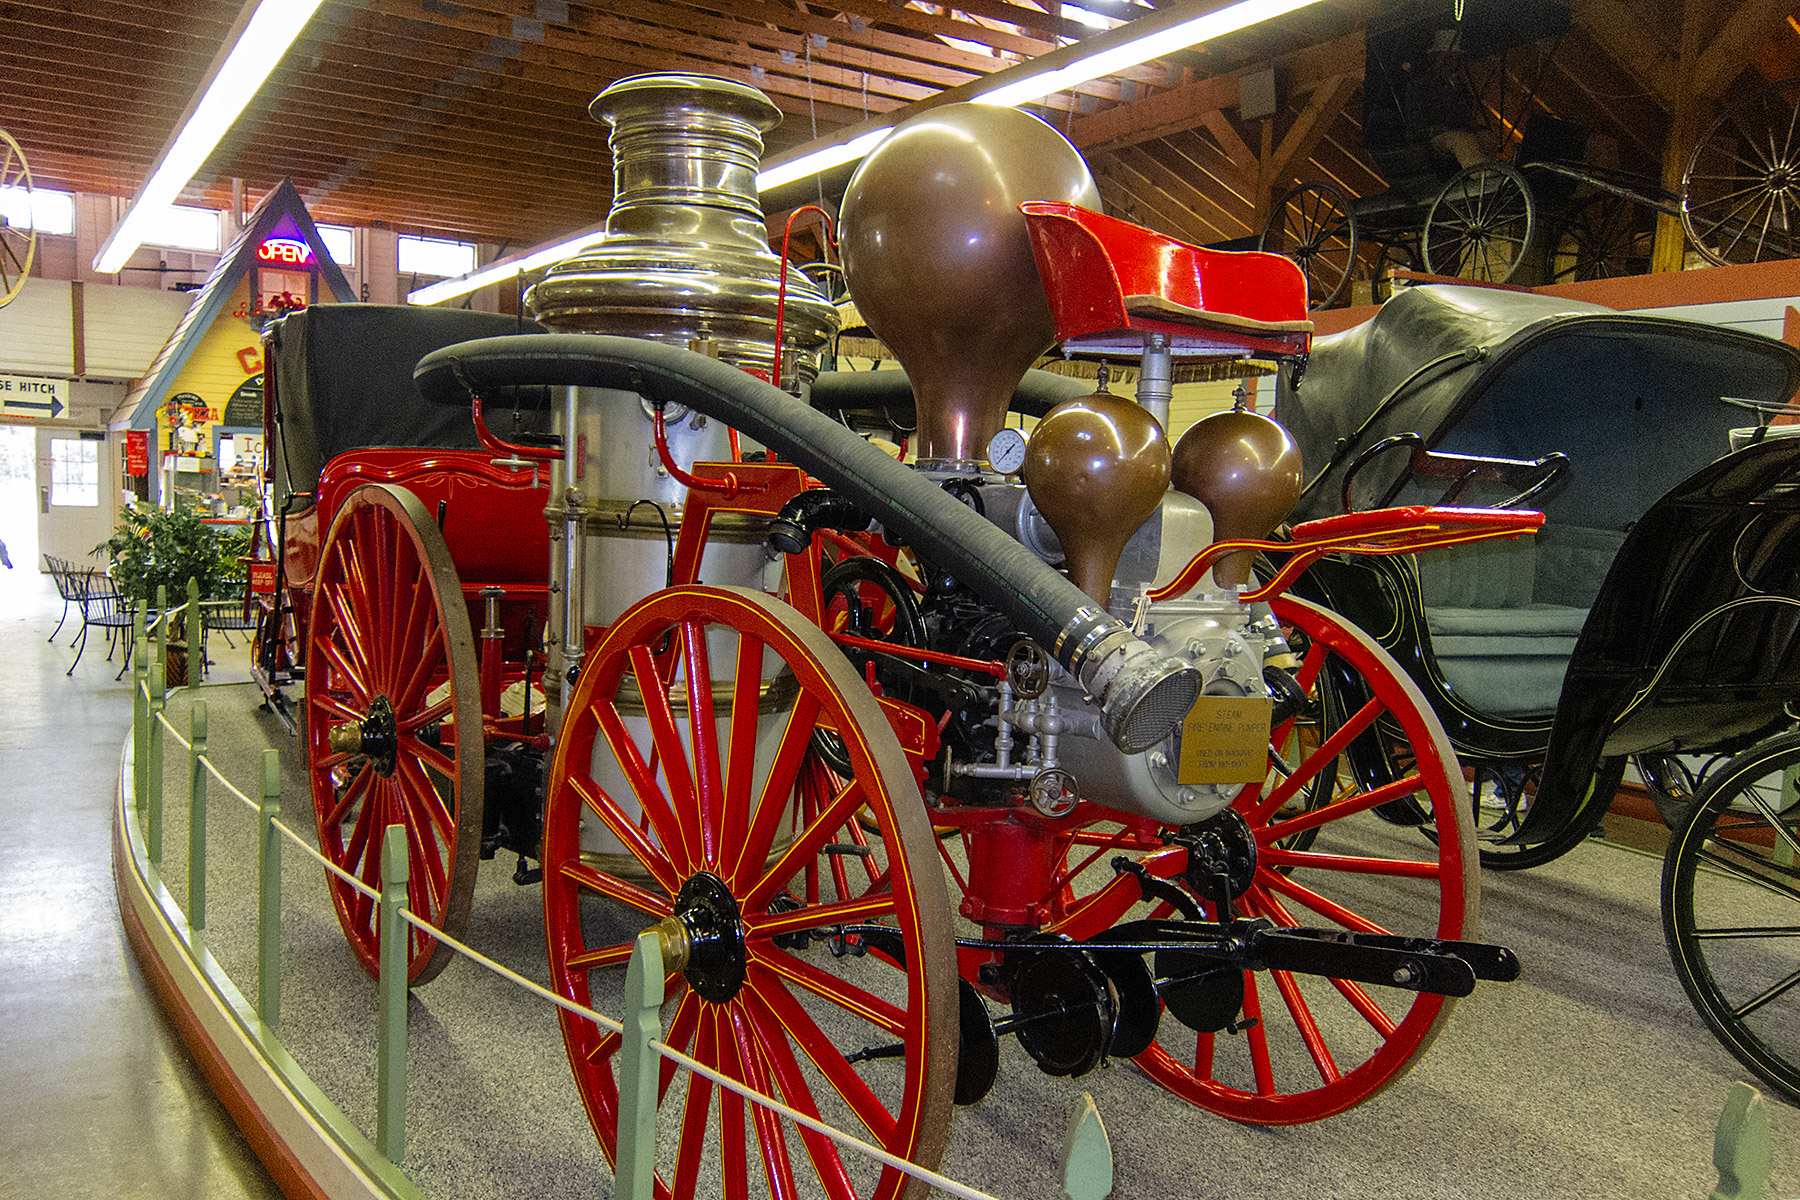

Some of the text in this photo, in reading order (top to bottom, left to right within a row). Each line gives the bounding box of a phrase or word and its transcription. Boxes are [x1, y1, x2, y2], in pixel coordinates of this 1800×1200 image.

[258, 242, 307, 263] OPEN
[19, 382, 55, 394] HITCH
[253, 571, 273, 579] PLEASE
[1216, 709, 1242, 719] STEAM
[1187, 722, 1266, 732] FIRE ENGINE PUMPER
